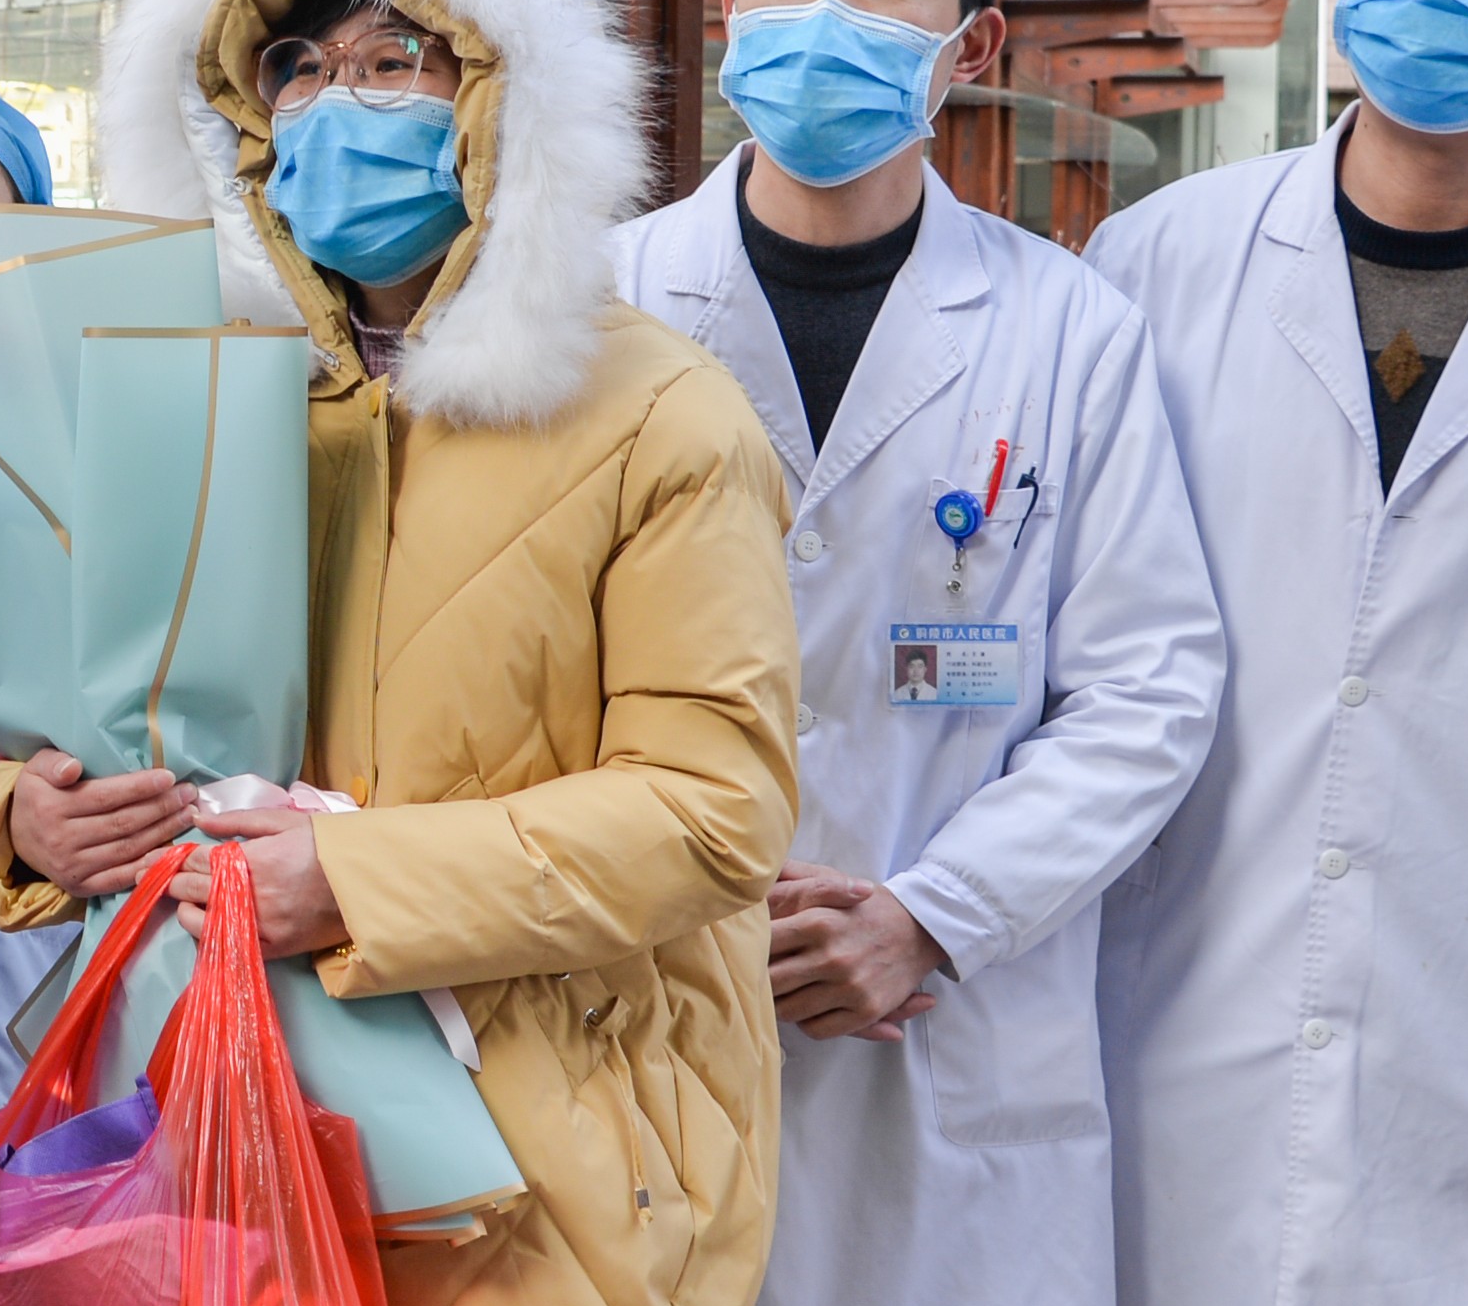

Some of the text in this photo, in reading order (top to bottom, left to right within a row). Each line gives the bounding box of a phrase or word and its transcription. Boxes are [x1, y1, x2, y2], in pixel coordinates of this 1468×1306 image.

[915, 627, 1007, 641] 铜陵市人民医院
